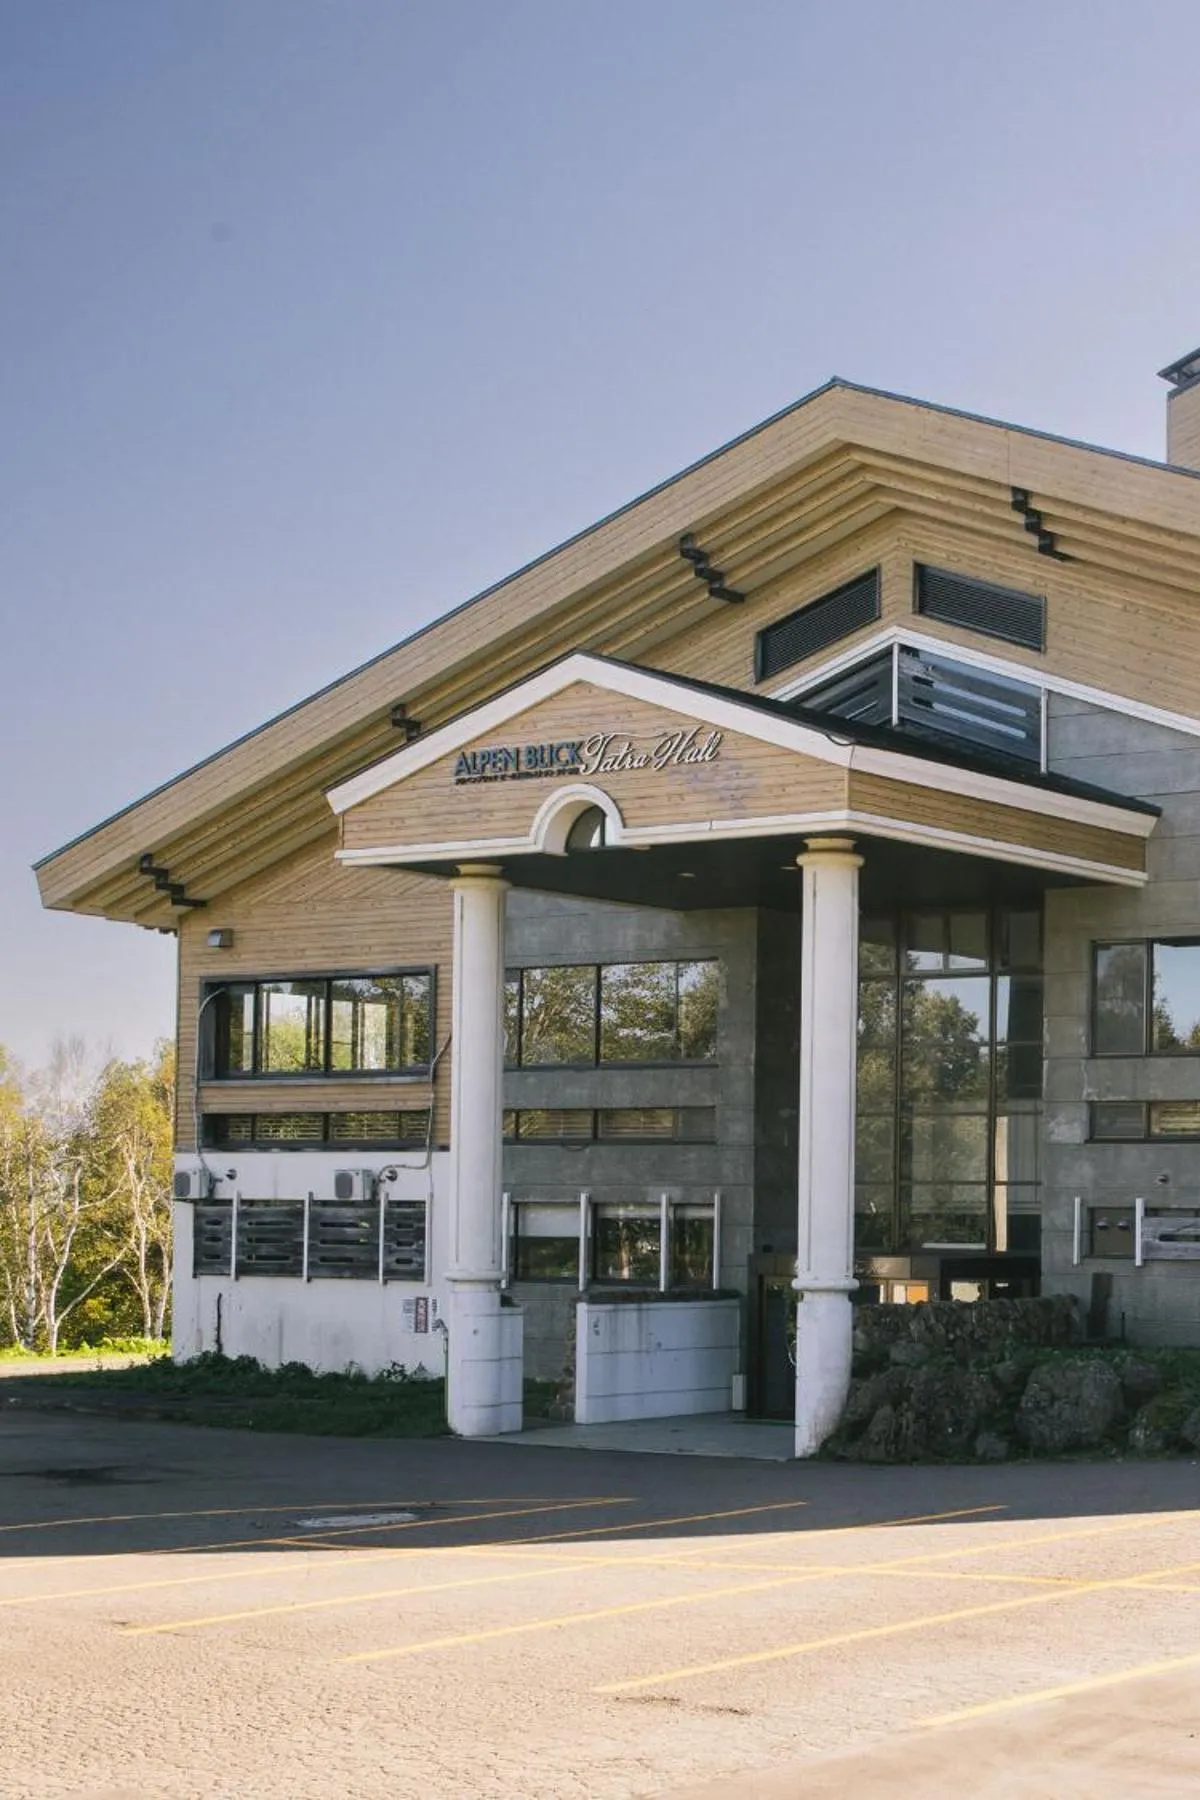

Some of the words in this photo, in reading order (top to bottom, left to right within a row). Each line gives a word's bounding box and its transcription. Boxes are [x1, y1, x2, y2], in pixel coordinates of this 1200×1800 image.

[454, 747, 520, 777] ALPEN
[526, 741, 585, 769] BLICK
[652, 726, 722, 771] Hall
